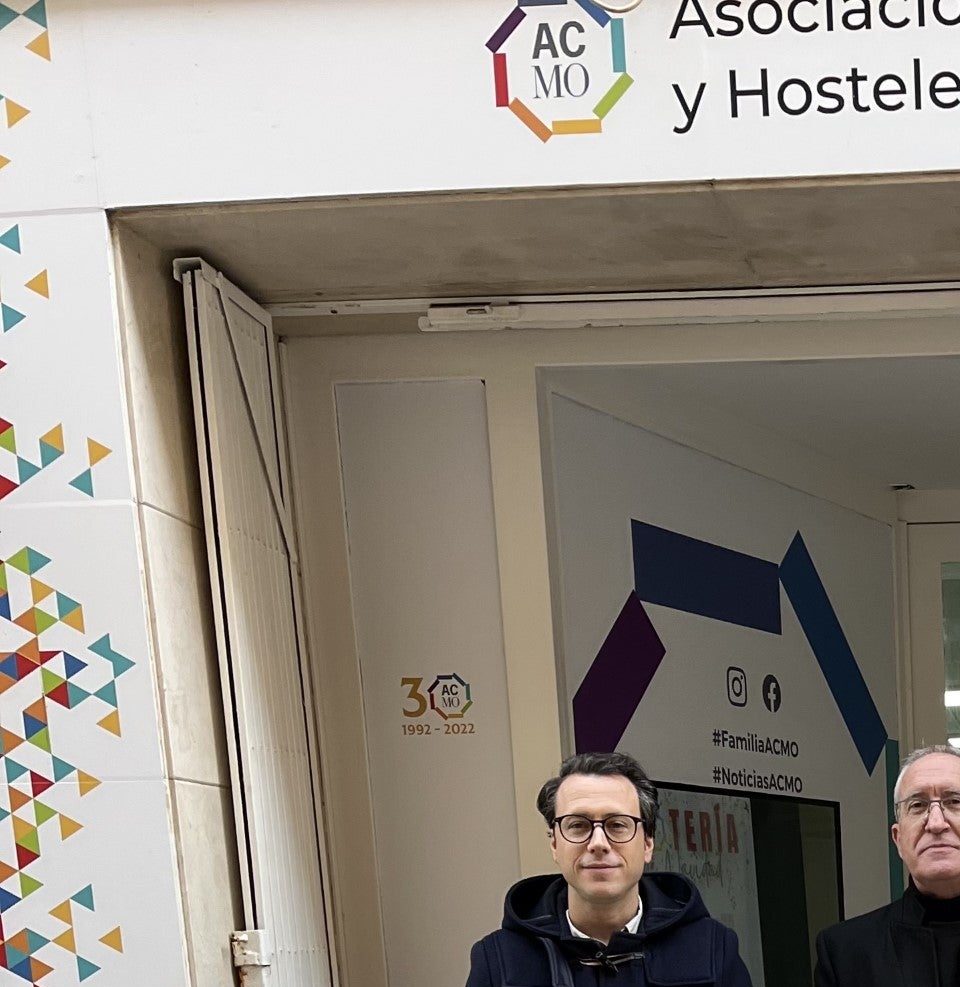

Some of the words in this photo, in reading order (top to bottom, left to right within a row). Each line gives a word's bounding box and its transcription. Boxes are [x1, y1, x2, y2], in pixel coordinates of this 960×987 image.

[531, 20, 587, 60] AC
[532, 62, 590, 99] MO
[672, 81, 706, 134] y
[441, 684, 459, 696] AC
[442, 696, 460, 708] MO
[712, 729, 799, 758] #FamiliaACMO
[712, 766, 803, 793] #NoticiasACMO
